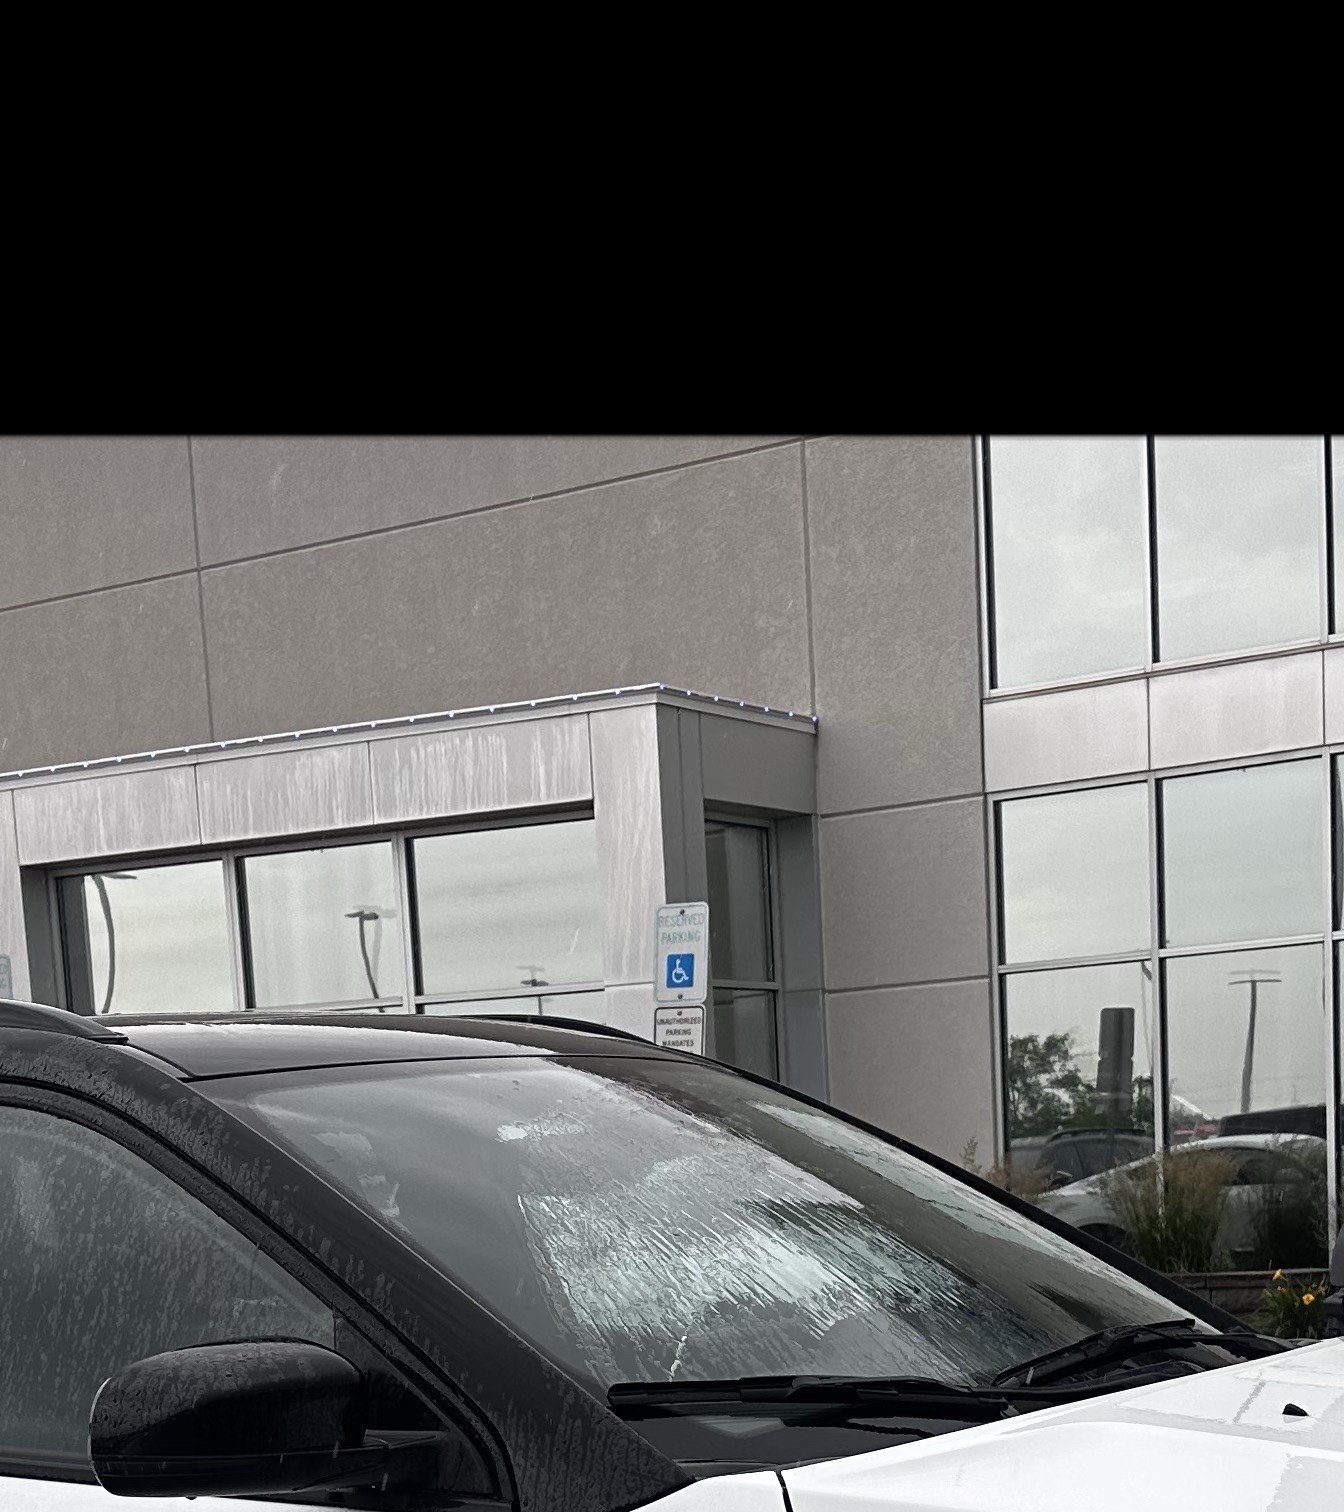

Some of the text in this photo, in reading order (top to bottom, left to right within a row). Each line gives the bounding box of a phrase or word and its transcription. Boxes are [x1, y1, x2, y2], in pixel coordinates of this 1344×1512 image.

[658, 912, 705, 929] RESERVED
[661, 930, 701, 945] PARKING
[665, 1028, 692, 1037] PARKING
